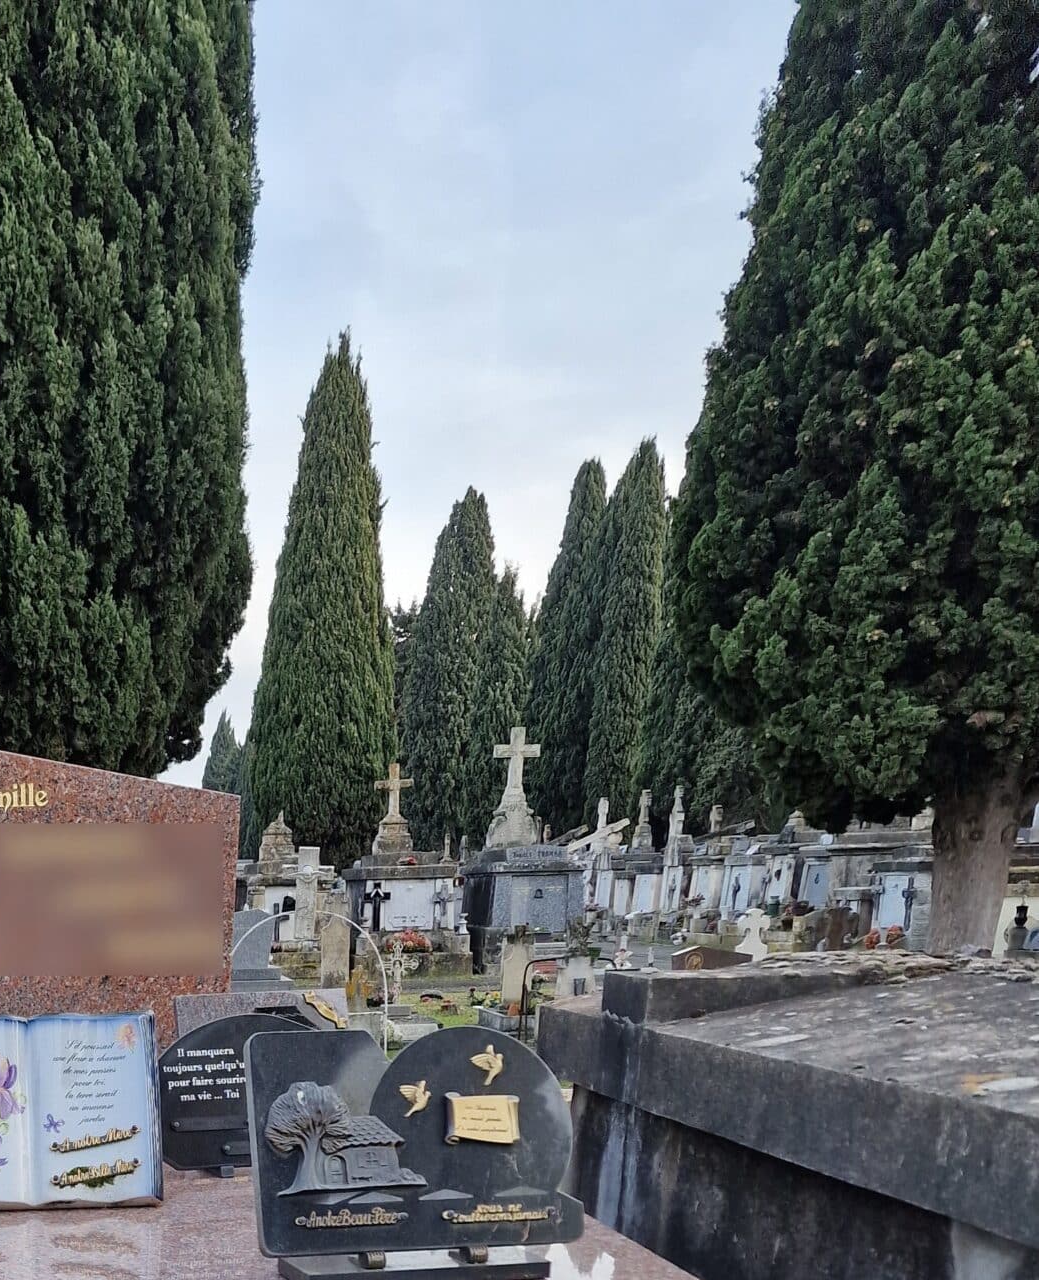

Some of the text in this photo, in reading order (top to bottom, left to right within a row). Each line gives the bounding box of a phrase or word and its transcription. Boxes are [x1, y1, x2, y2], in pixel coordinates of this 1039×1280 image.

[66, 1053, 87, 1064] fleur
[177, 1048, 235, 1058] Il manquera
[163, 1060, 246, 1075] toujours quelqu'u
[168, 1080, 191, 1090] pour
[192, 1076, 214, 1086] faire
[197, 1090, 212, 1100] vie
[224, 1089, 240, 1098] Toi
